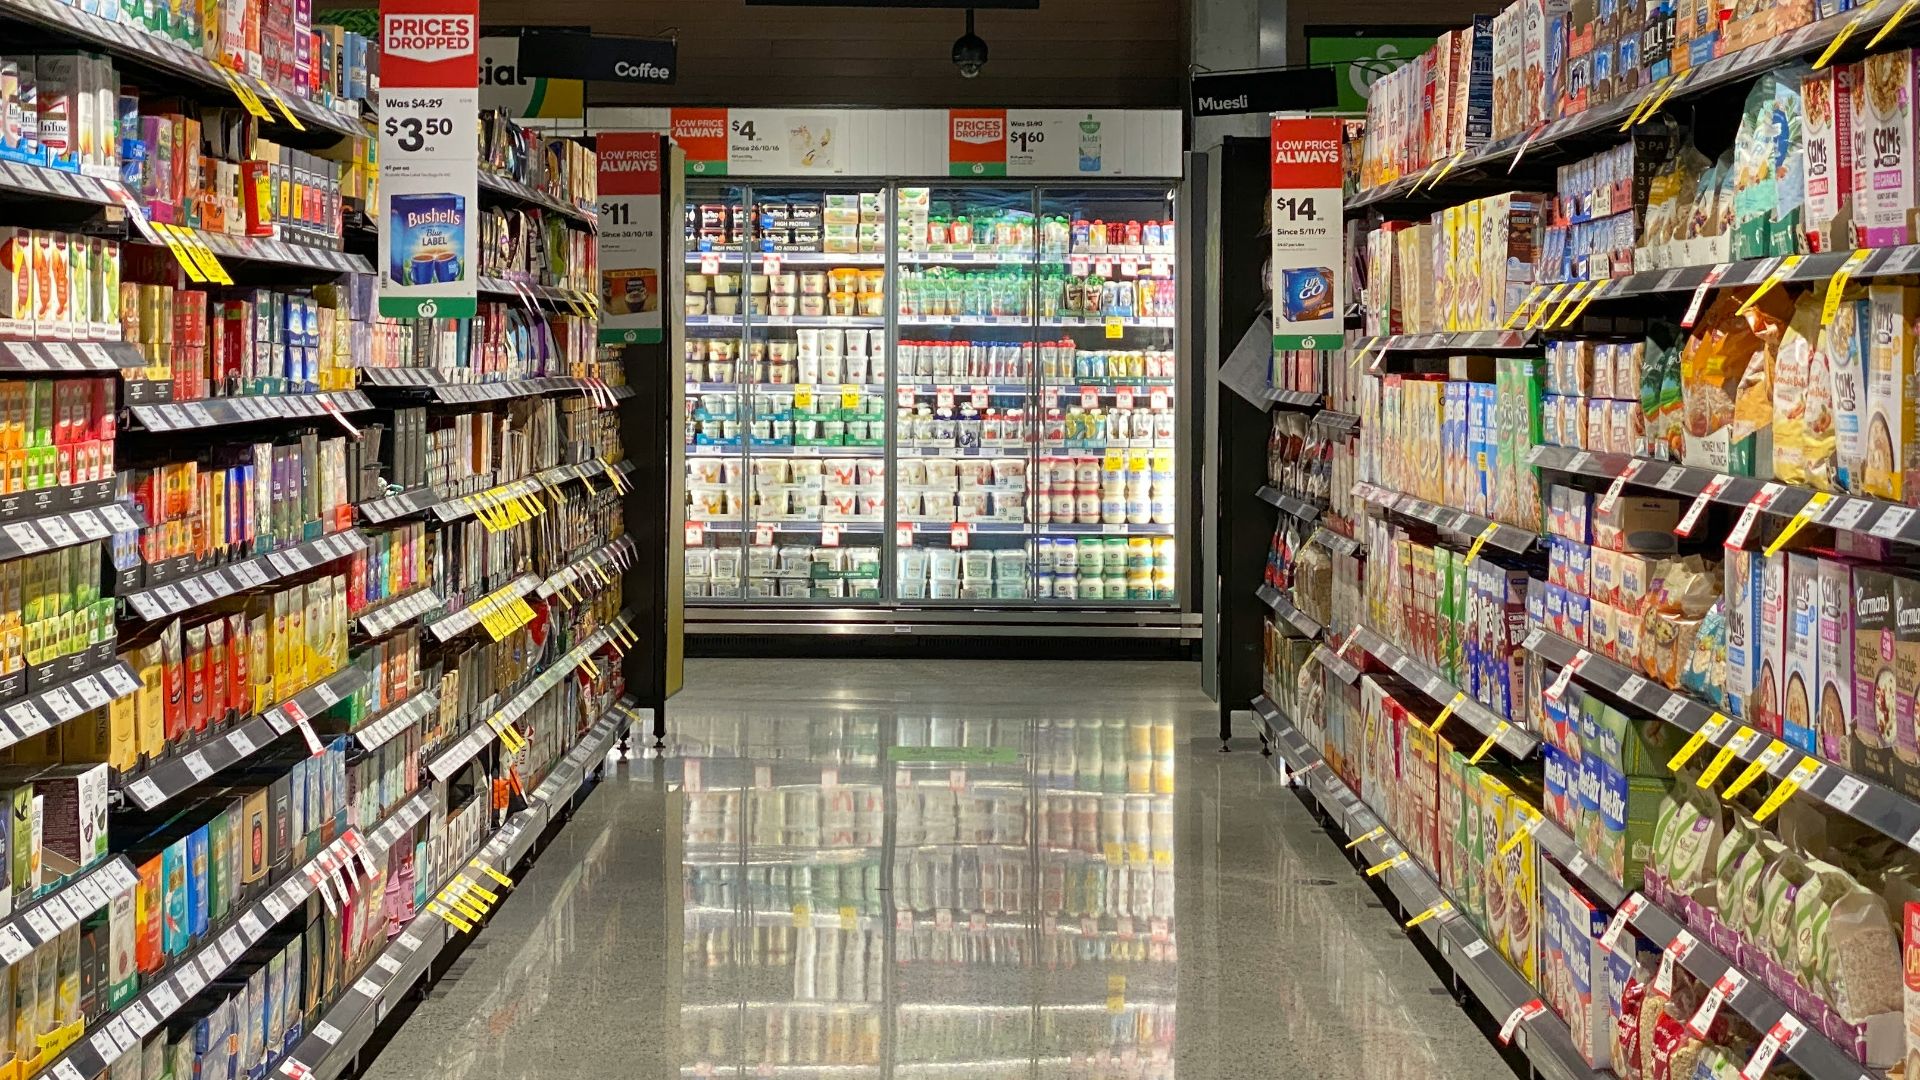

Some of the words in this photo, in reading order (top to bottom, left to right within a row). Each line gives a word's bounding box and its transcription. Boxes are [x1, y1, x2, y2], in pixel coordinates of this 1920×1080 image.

[389, 19, 469, 36] PRICES
[388, 37, 469, 49] DROPPED
[614, 61, 670, 79] Coffee
[385, 99, 409, 108] Was
[412, 98, 443, 108] $4.29
[1198, 94, 1248, 111] Muesli
[698, 119, 724, 127] PRICE
[955, 120, 1001, 130] PRICES
[675, 128, 724, 138] ALWAYS
[731, 120, 756, 141] $4
[1276, 140, 1302, 150] LOW
[1304, 140, 1338, 150] PRICE
[600, 151, 624, 160] LOW
[626, 150, 657, 159] PRICE
[1275, 151, 1339, 163] ALWAYS
[600, 160, 658, 172] ALWAYS
[601, 203, 629, 225] $11
[1276, 197, 1316, 221] $14
[408, 208, 460, 227] Bushells
[426, 229, 442, 237] Blue
[622, 230, 653, 238] 30/10/18
[1300, 227, 1326, 235] 5/11/19
[422, 237, 447, 246] LABEL
[1299, 285, 1324, 299] GO
[1716, 440, 1726, 453] NUT
[1856, 586, 1890, 616] Carman's
